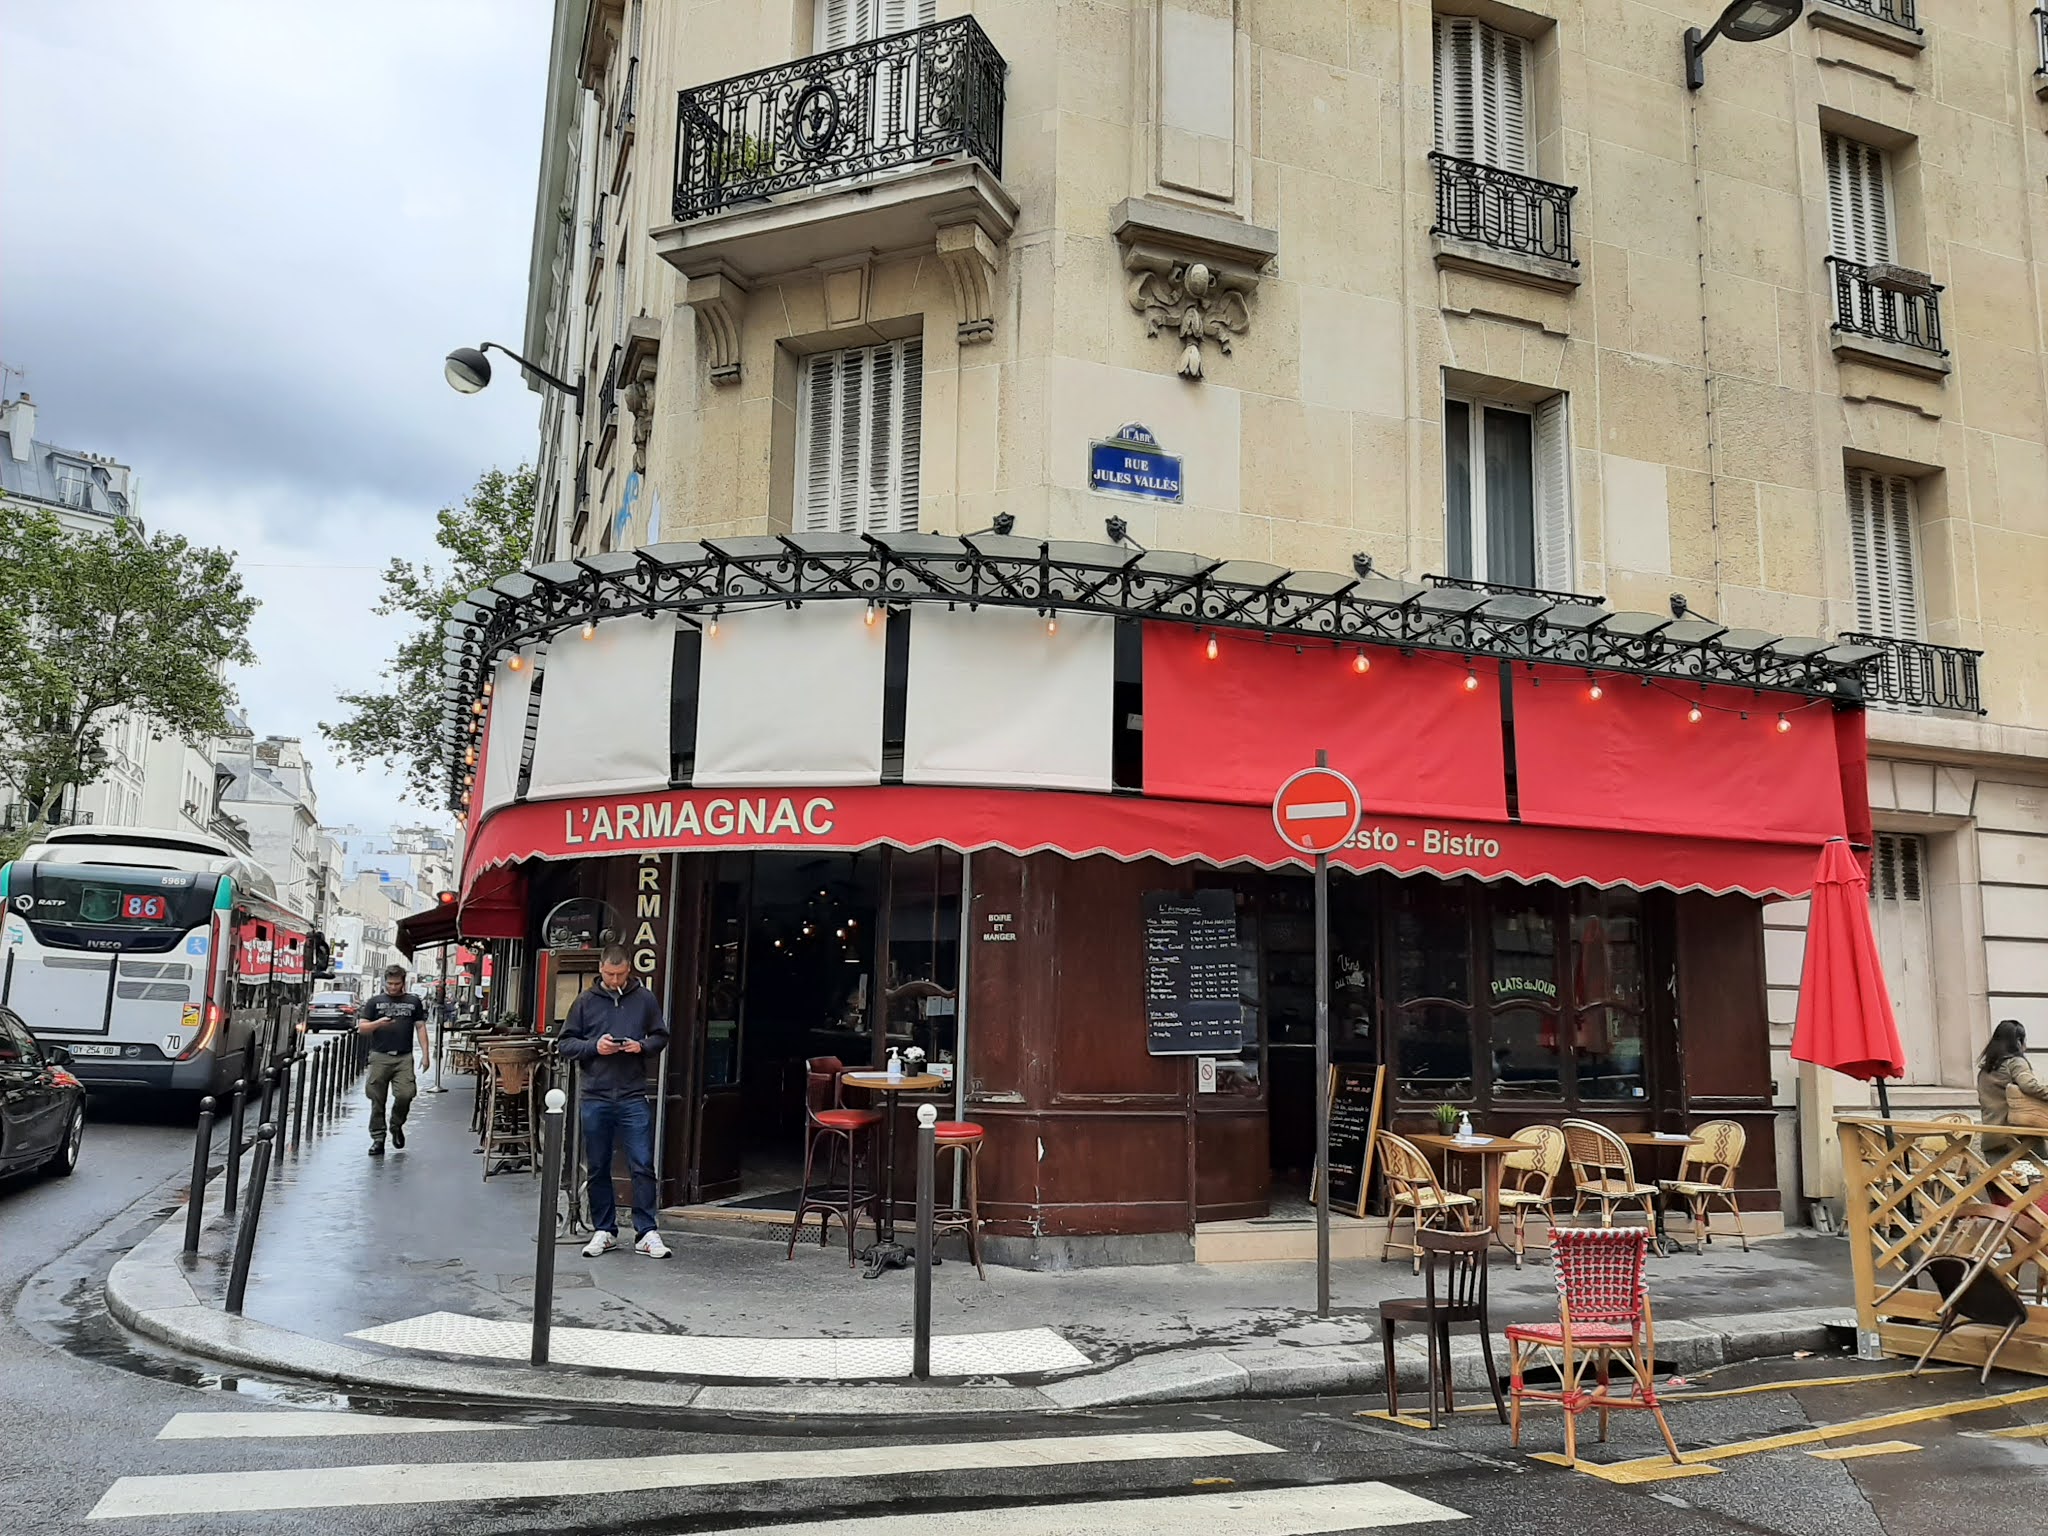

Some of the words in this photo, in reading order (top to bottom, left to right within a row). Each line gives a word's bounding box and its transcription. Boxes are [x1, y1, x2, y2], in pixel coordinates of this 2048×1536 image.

[1124, 457, 1149, 471] RUE
[1093, 468, 1131, 485] JULES
[565, 797, 834, 844] L'ARMAGNAC
[1343, 826, 1398, 851] esto
[1423, 828, 1500, 858] Bistro
[161, 876, 187, 886] 5969
[128, 897, 158, 916] 86
[632, 853, 661, 992] RMAG
[988, 913, 1013, 922] BOIRE
[993, 923, 1004, 931] ET
[87, 940, 122, 949] IVECO
[983, 933, 1017, 941] MANGER
[1490, 977, 1523, 995] PLATS
[1532, 979, 1557, 998] JOUR
[166, 1034, 181, 1050] 70
